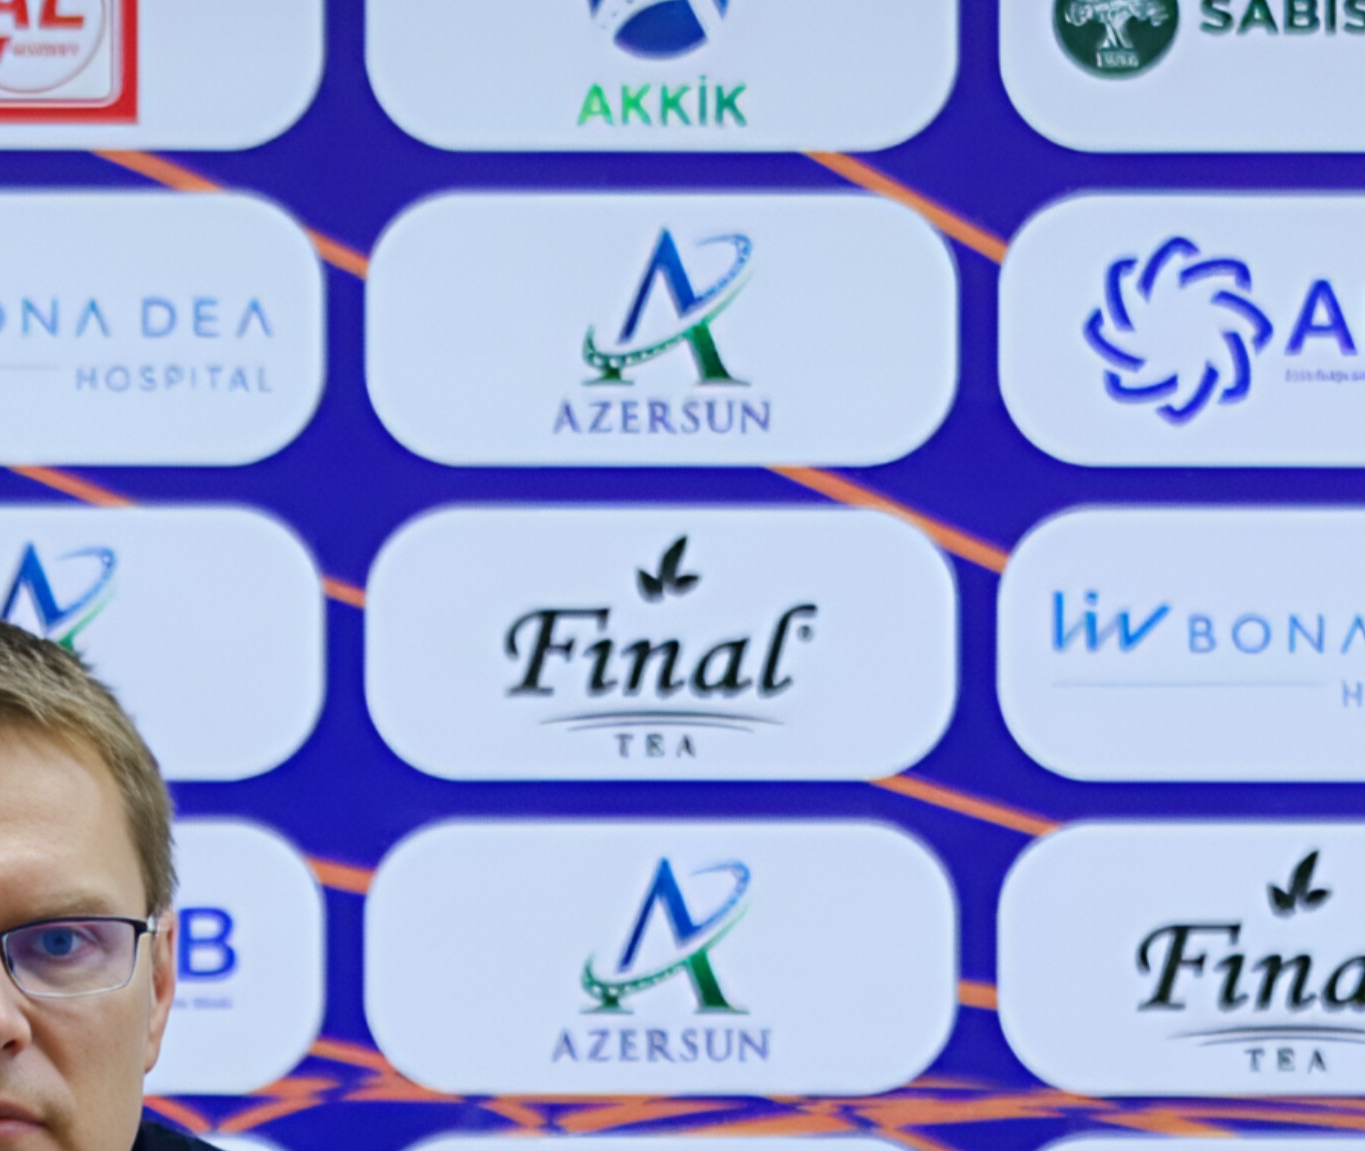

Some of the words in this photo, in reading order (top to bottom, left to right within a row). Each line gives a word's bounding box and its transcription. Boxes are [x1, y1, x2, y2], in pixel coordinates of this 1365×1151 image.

[577, 74, 747, 127] AKKİK
[141, 296, 272, 338] DEA
[76, 366, 271, 392] HOSPITAL
[553, 398, 770, 434] AZERSUN
[1052, 589, 1173, 653] liv
[503, 603, 818, 699] Final
[615, 733, 696, 758] TEA
[1136, 922, 1365, 1013] Fina
[552, 1027, 771, 1062] AZERSUN
[1245, 1047, 1327, 1072] TEA
